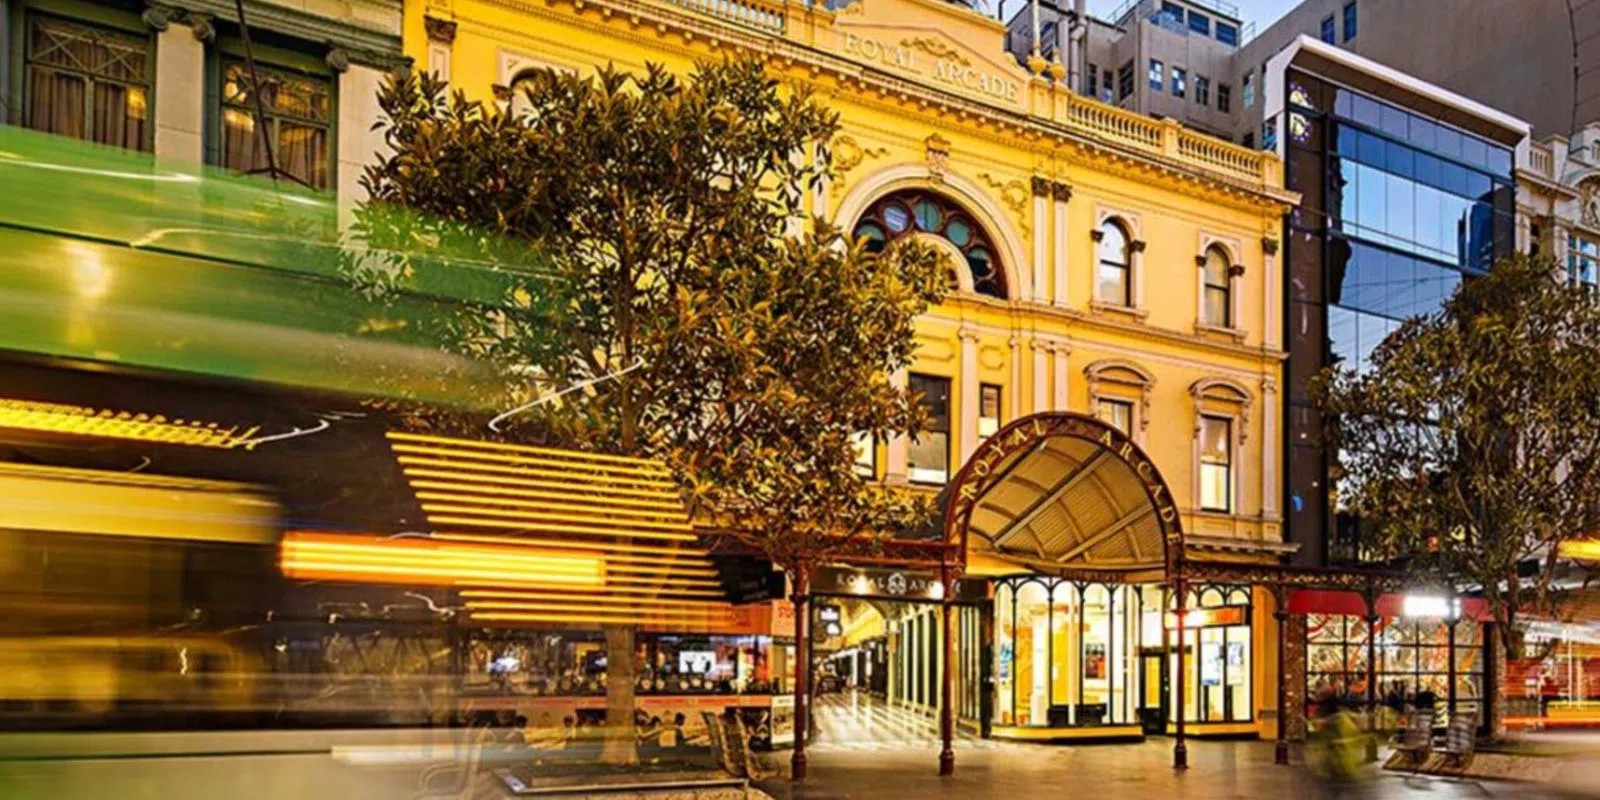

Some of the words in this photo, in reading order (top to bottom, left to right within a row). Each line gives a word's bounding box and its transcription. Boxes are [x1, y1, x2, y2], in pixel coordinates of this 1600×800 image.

[845, 32, 921, 73] ROYAL
[932, 59, 1018, 102] ARCADE
[960, 418, 1047, 500] ROYAL
[1099, 429, 1181, 544] ARCADE
[836, 574, 886, 591] ROAL
